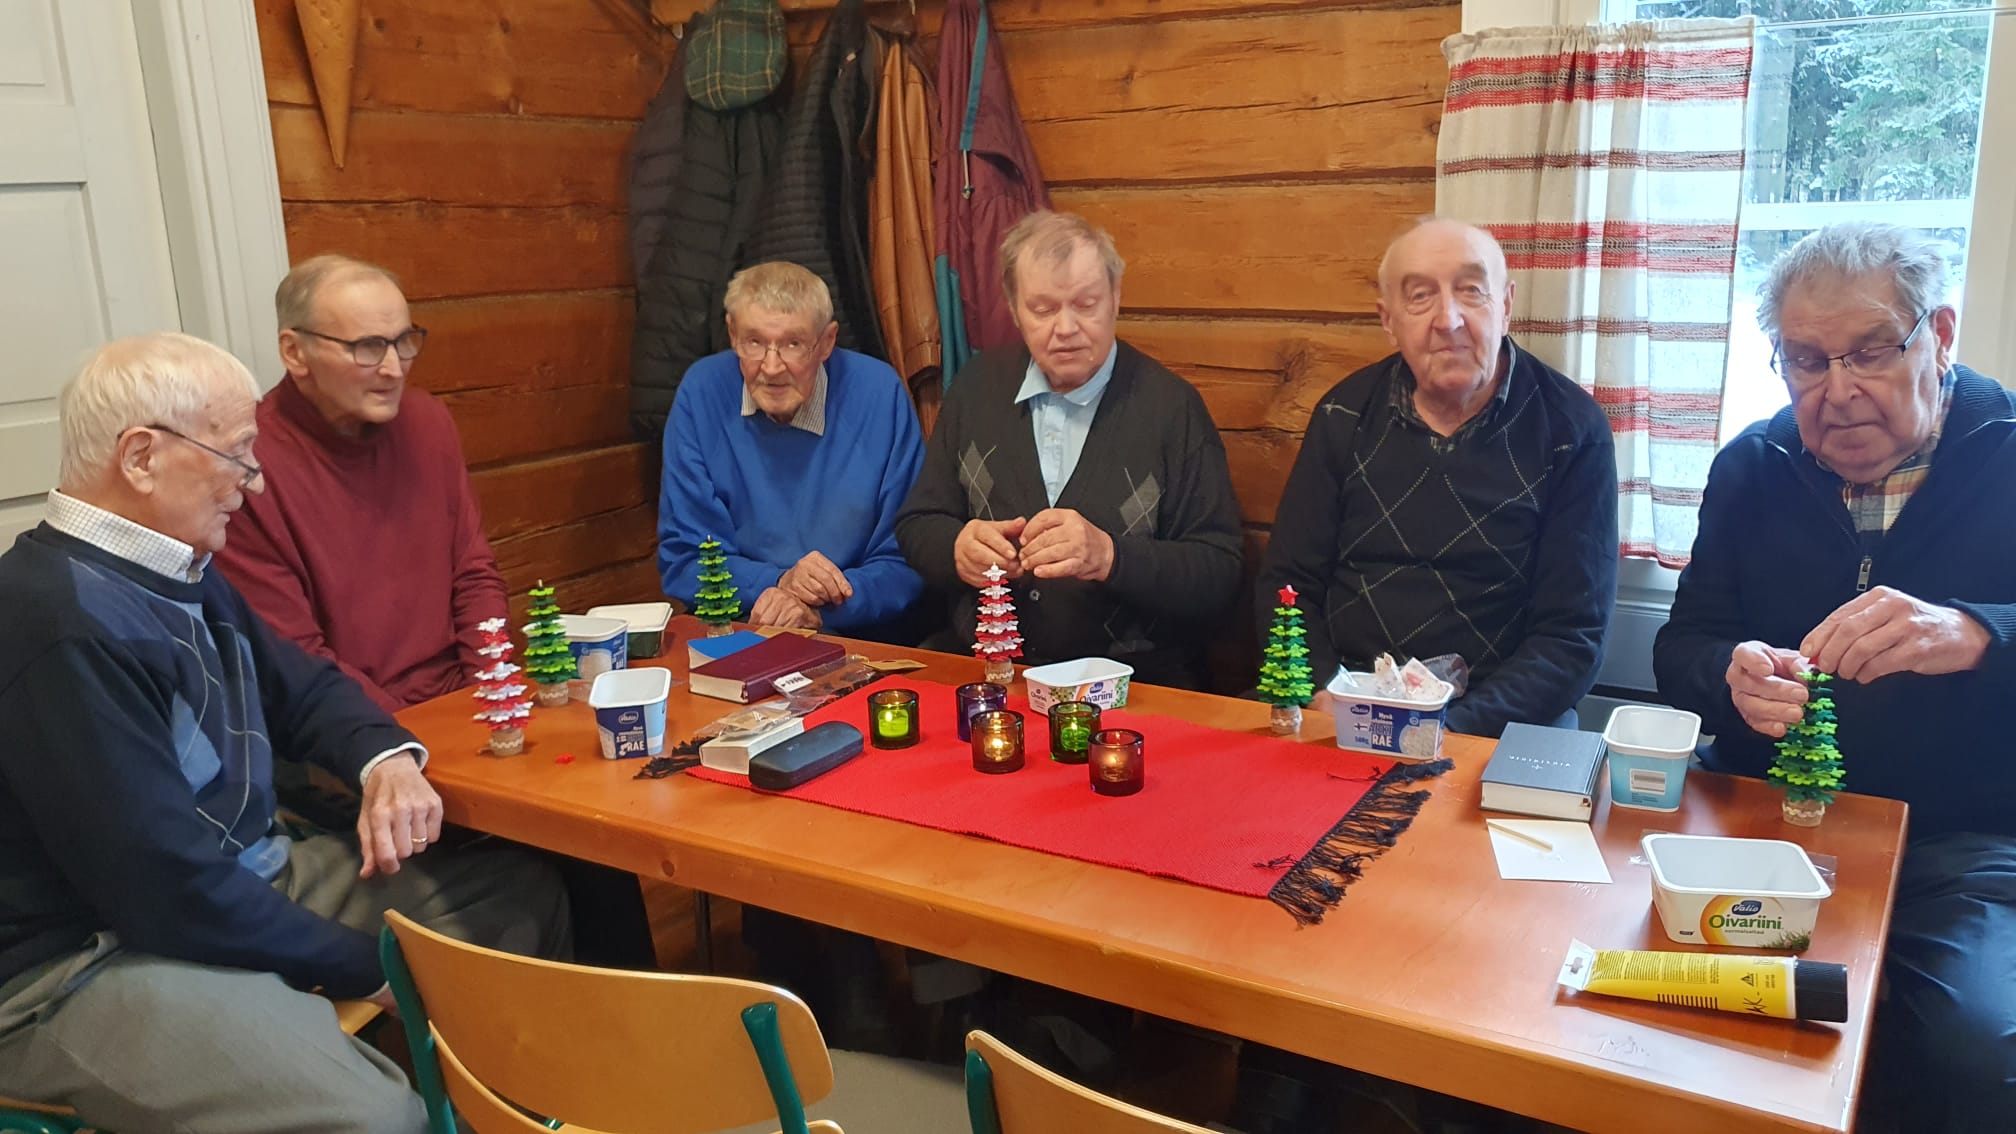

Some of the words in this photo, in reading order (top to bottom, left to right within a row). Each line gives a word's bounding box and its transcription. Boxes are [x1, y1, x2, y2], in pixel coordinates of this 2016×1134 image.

[1372, 734, 1392, 747] RAE
[1732, 903, 1760, 912] Valio
[1709, 914, 1782, 930] Oivariini
